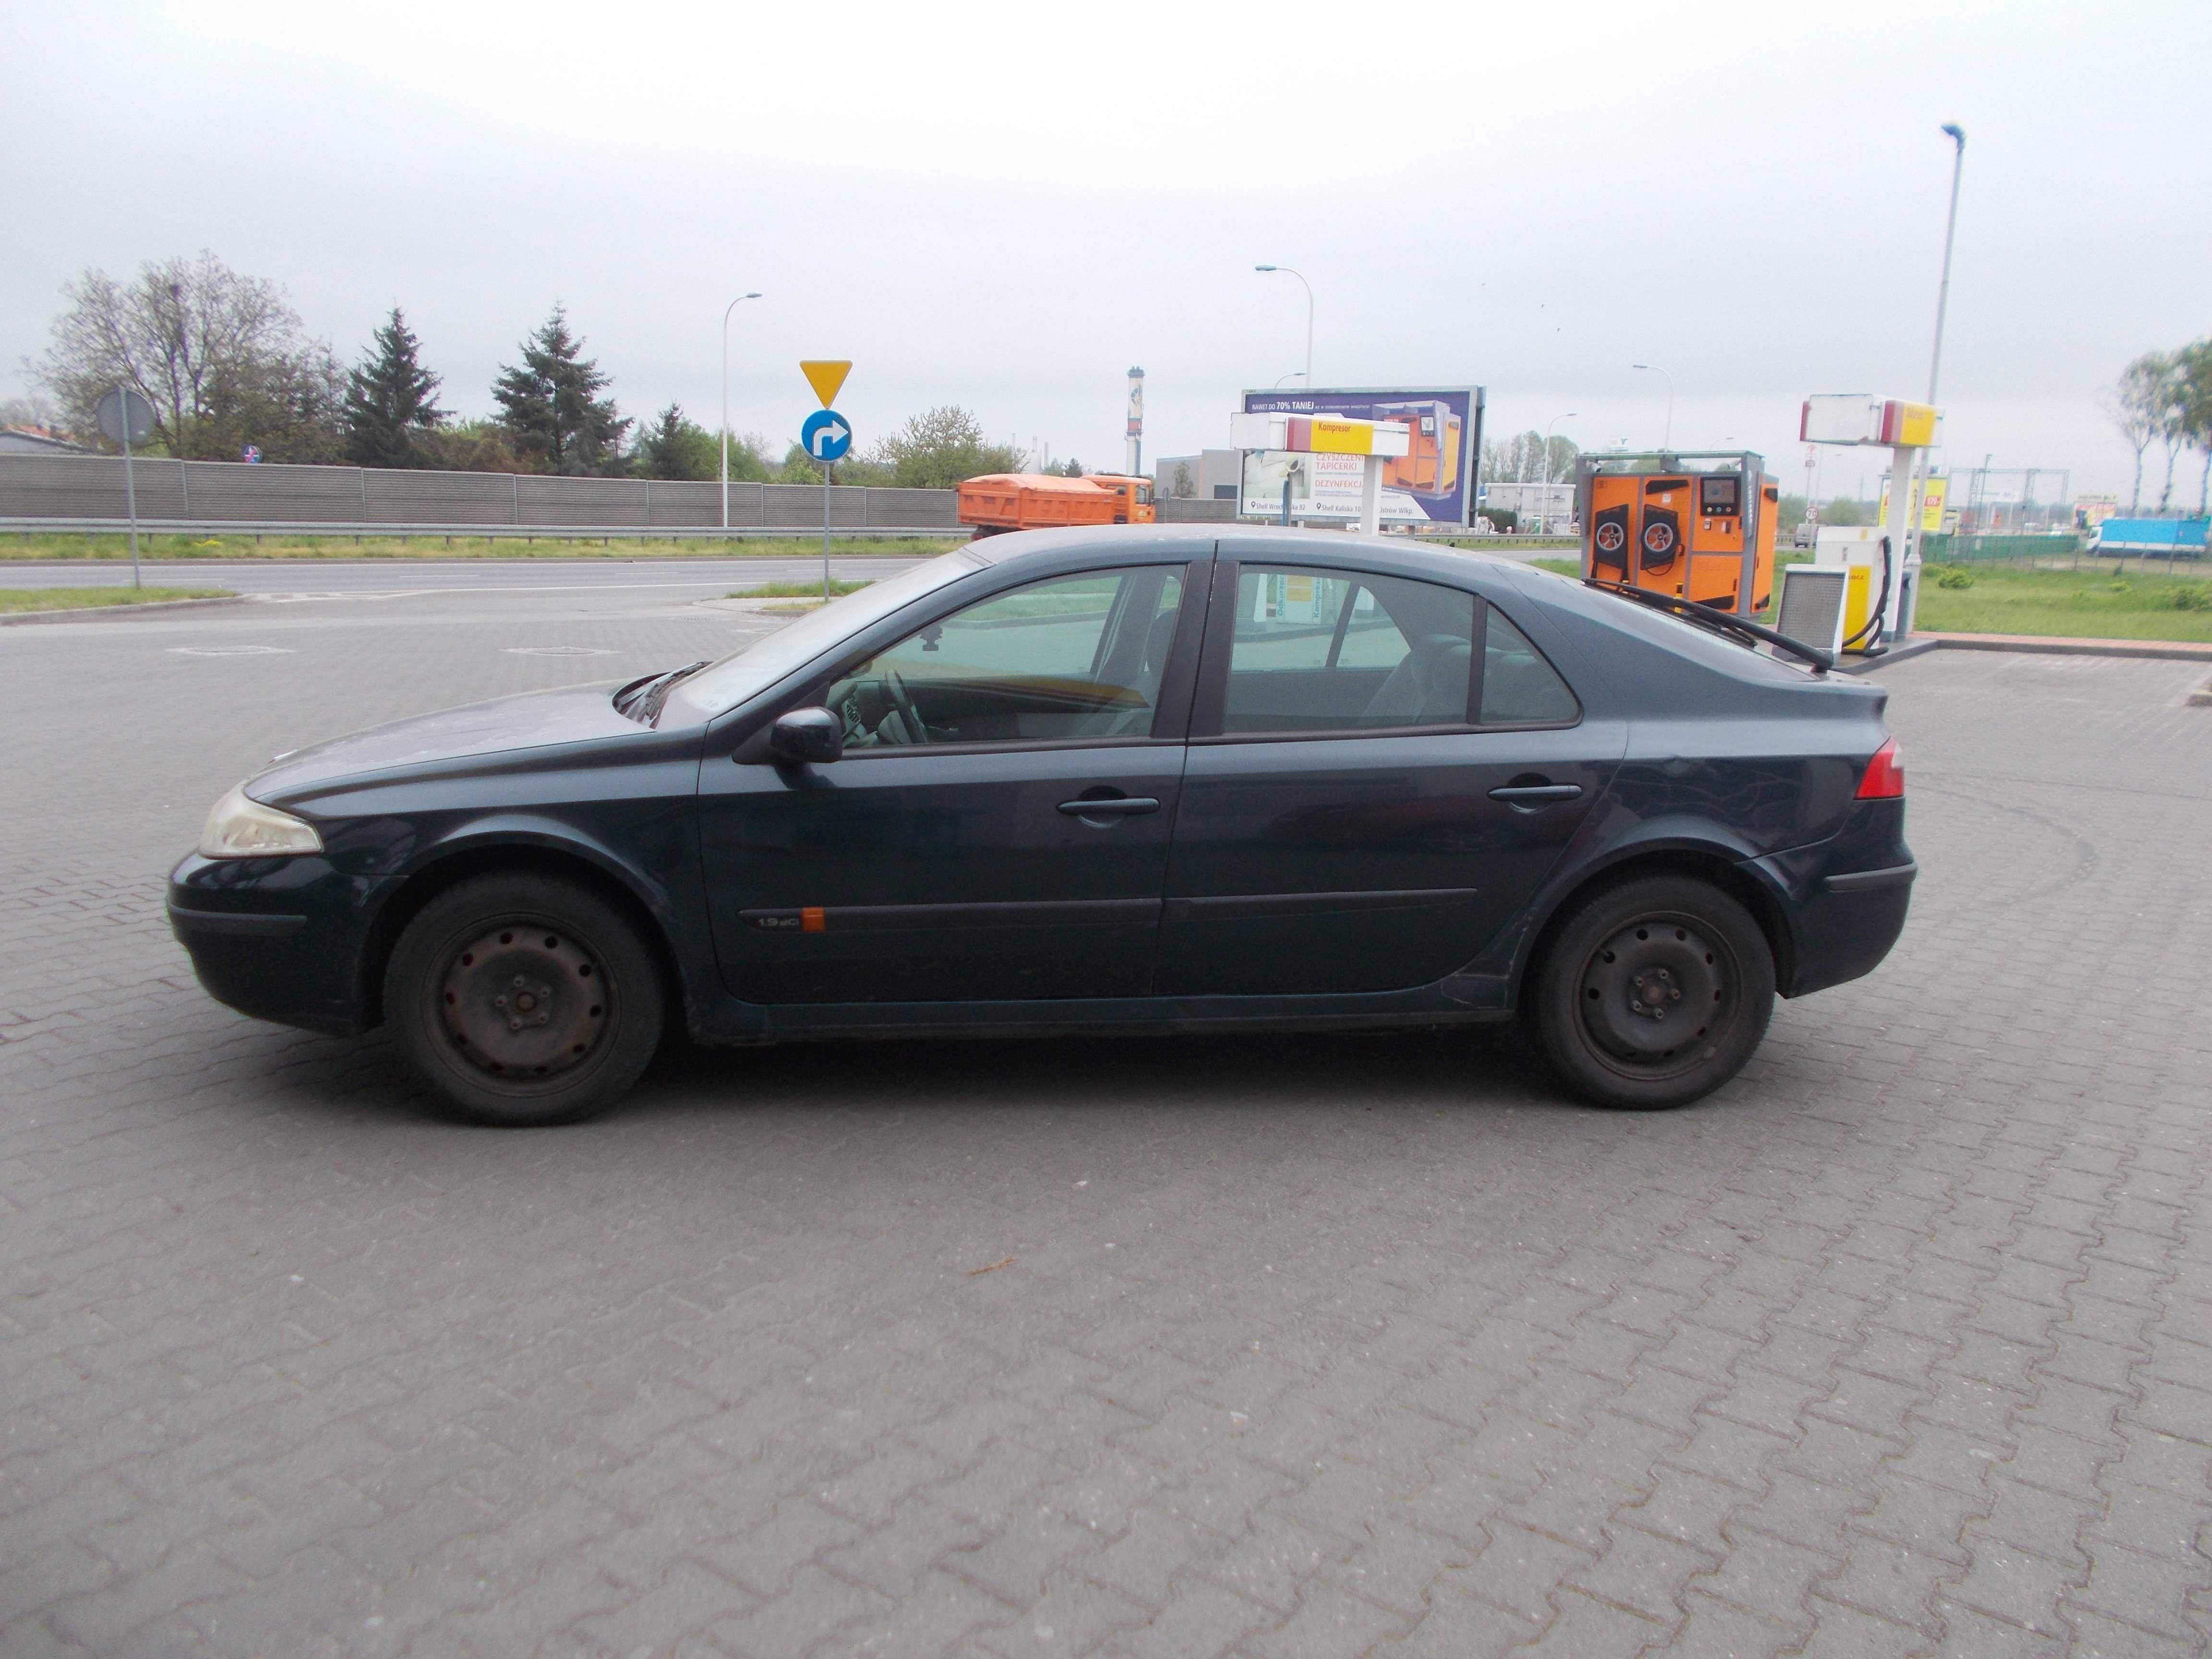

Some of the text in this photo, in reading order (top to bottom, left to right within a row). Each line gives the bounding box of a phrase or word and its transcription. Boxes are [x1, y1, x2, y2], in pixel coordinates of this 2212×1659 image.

[1292, 401, 1314, 409] TANIEJ
[1318, 422, 1351, 433] Kompresor
[1316, 462, 1357, 470] TAPICERKI
